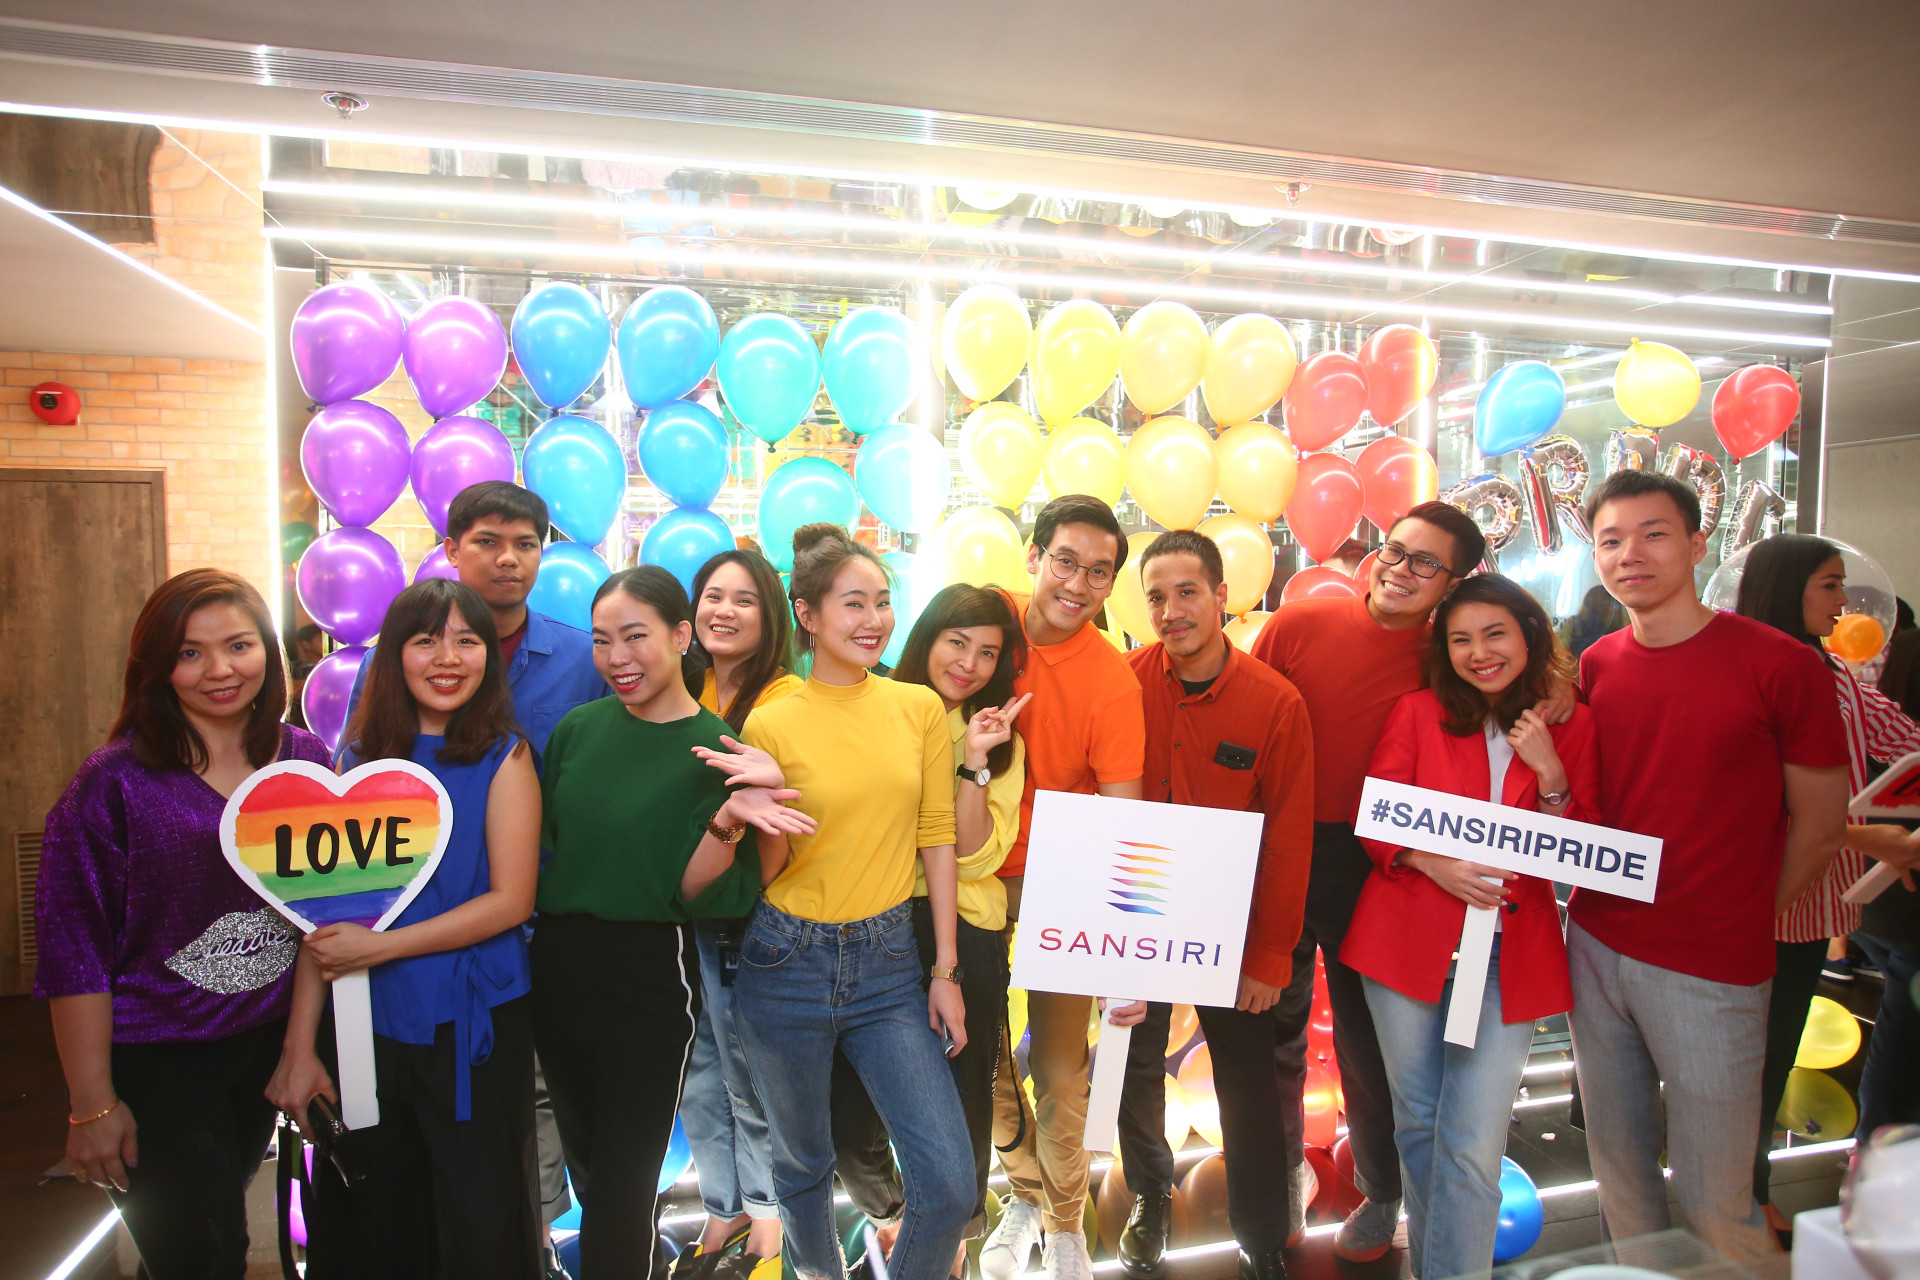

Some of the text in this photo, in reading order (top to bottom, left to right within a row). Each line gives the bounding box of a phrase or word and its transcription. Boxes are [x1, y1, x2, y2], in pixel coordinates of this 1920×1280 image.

[275, 816, 414, 878] LOVE
[1371, 799, 1647, 881] #SANSIRIPRIDE
[1038, 928, 1222, 967] SANSIRI
